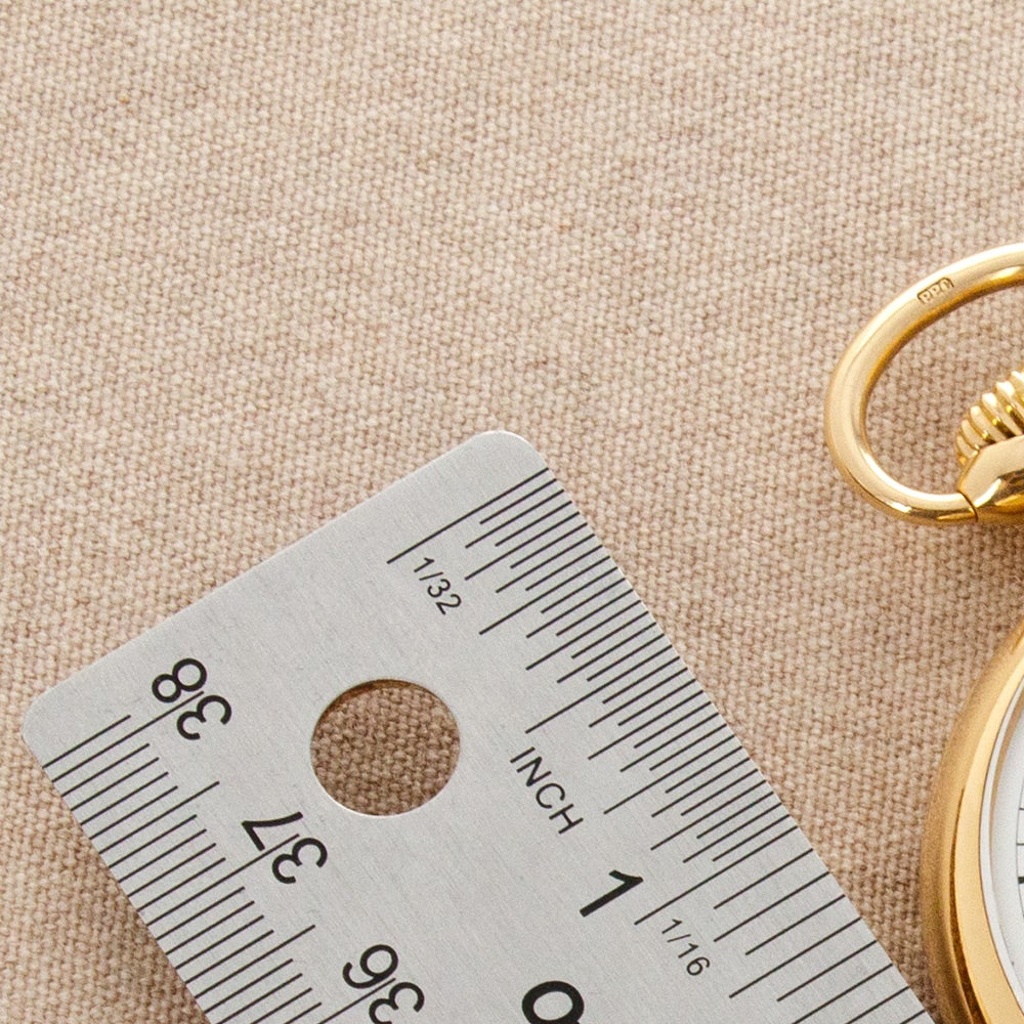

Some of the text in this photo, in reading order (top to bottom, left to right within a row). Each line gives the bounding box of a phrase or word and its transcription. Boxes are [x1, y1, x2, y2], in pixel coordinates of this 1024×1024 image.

[413, 556, 462, 615] 1/32
[151, 658, 232, 740] 38
[510, 746, 584, 835] INCH
[241, 811, 328, 885] 37
[580, 869, 644, 917] 1
[661, 918, 710, 977] 1/16
